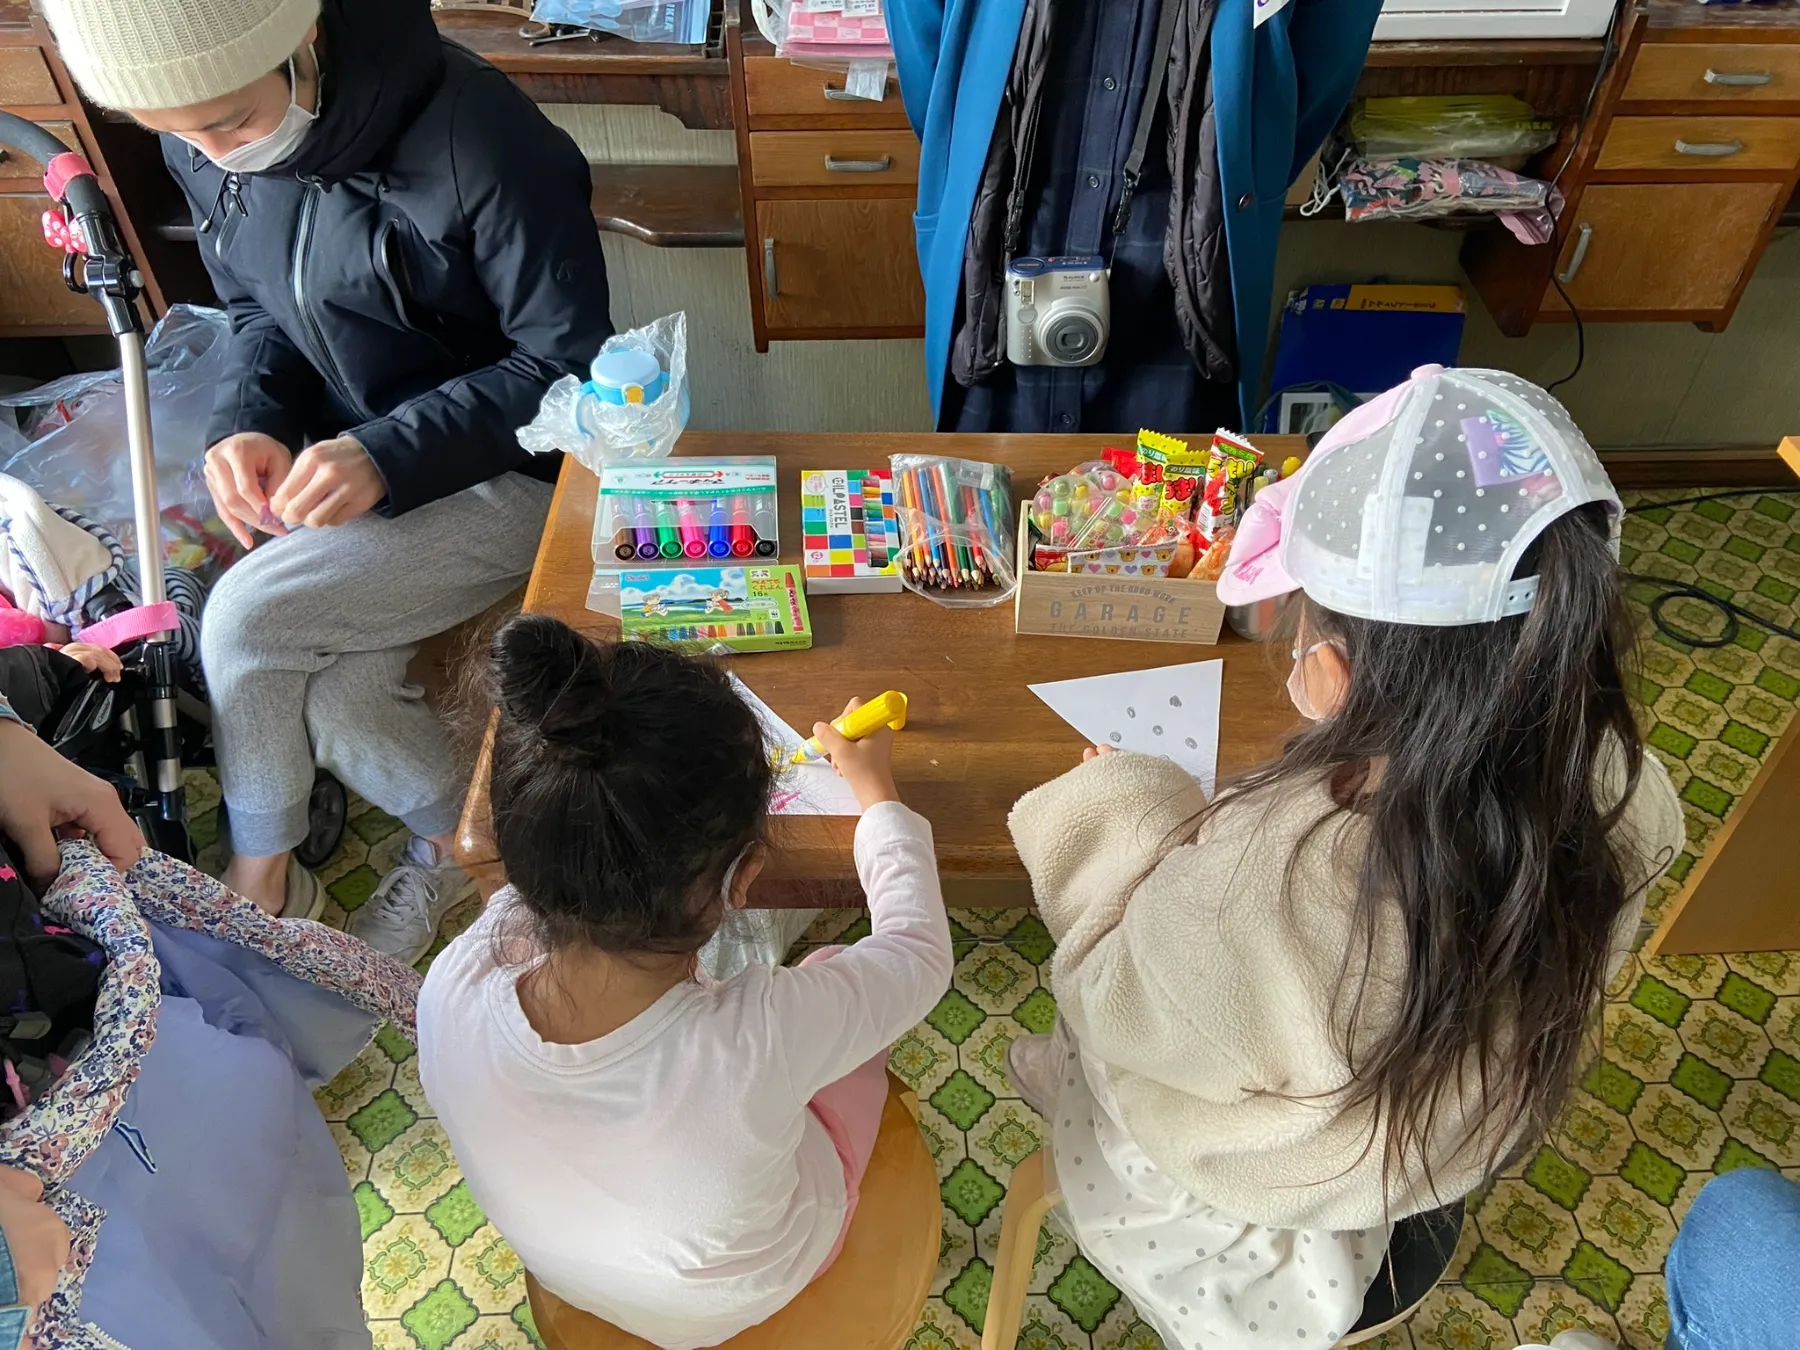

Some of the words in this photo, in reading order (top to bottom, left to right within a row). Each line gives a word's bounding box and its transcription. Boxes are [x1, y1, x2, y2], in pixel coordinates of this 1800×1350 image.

[664, 3, 676, 32] IKEA
[1070, 586, 1092, 598] KEEP
[1095, 585, 1105, 594] UP
[1109, 585, 1125, 593] THE
[1128, 585, 1151, 596] GOOD
[1050, 600, 1192, 624] GARAGE
[1050, 623, 1075, 632] THE
[1083, 624, 1137, 637] GOLDEN
[1144, 627, 1189, 639] STATE
